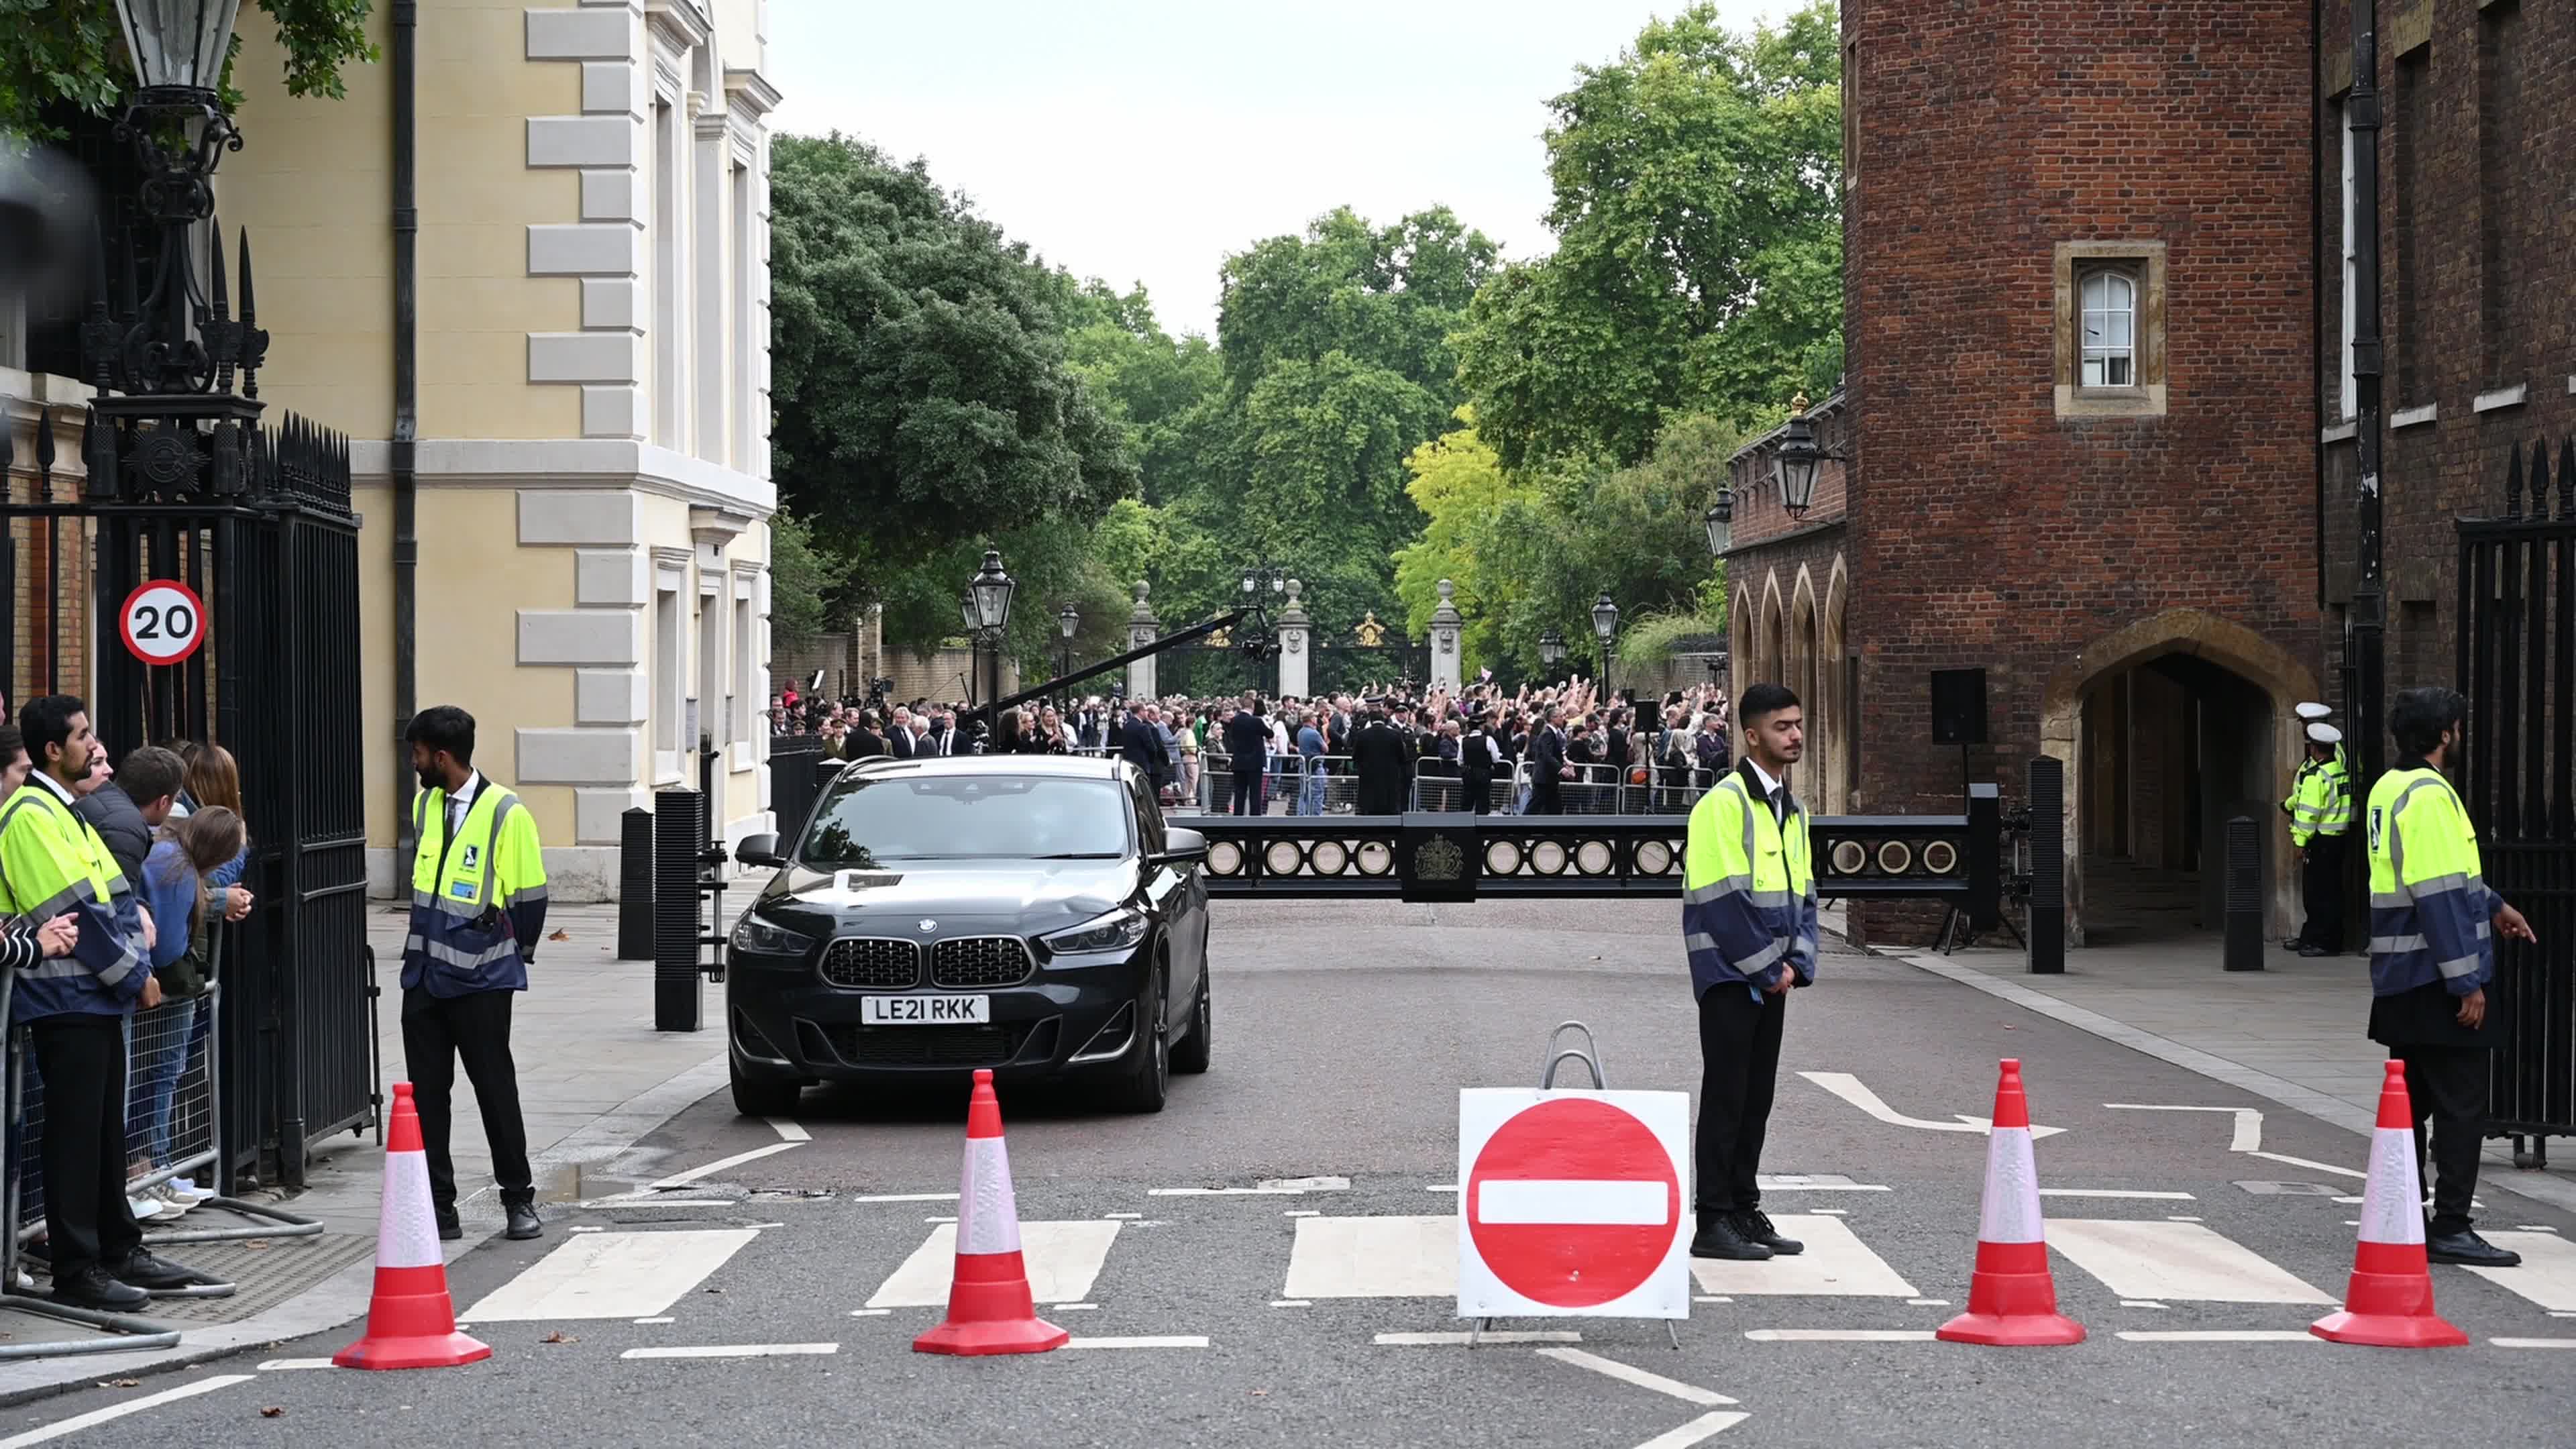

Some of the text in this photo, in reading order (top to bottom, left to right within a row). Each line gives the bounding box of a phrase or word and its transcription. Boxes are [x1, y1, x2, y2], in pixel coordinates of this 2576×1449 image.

[135, 604, 193, 639] 20
[875, 998, 975, 1020] LE21 RKK
